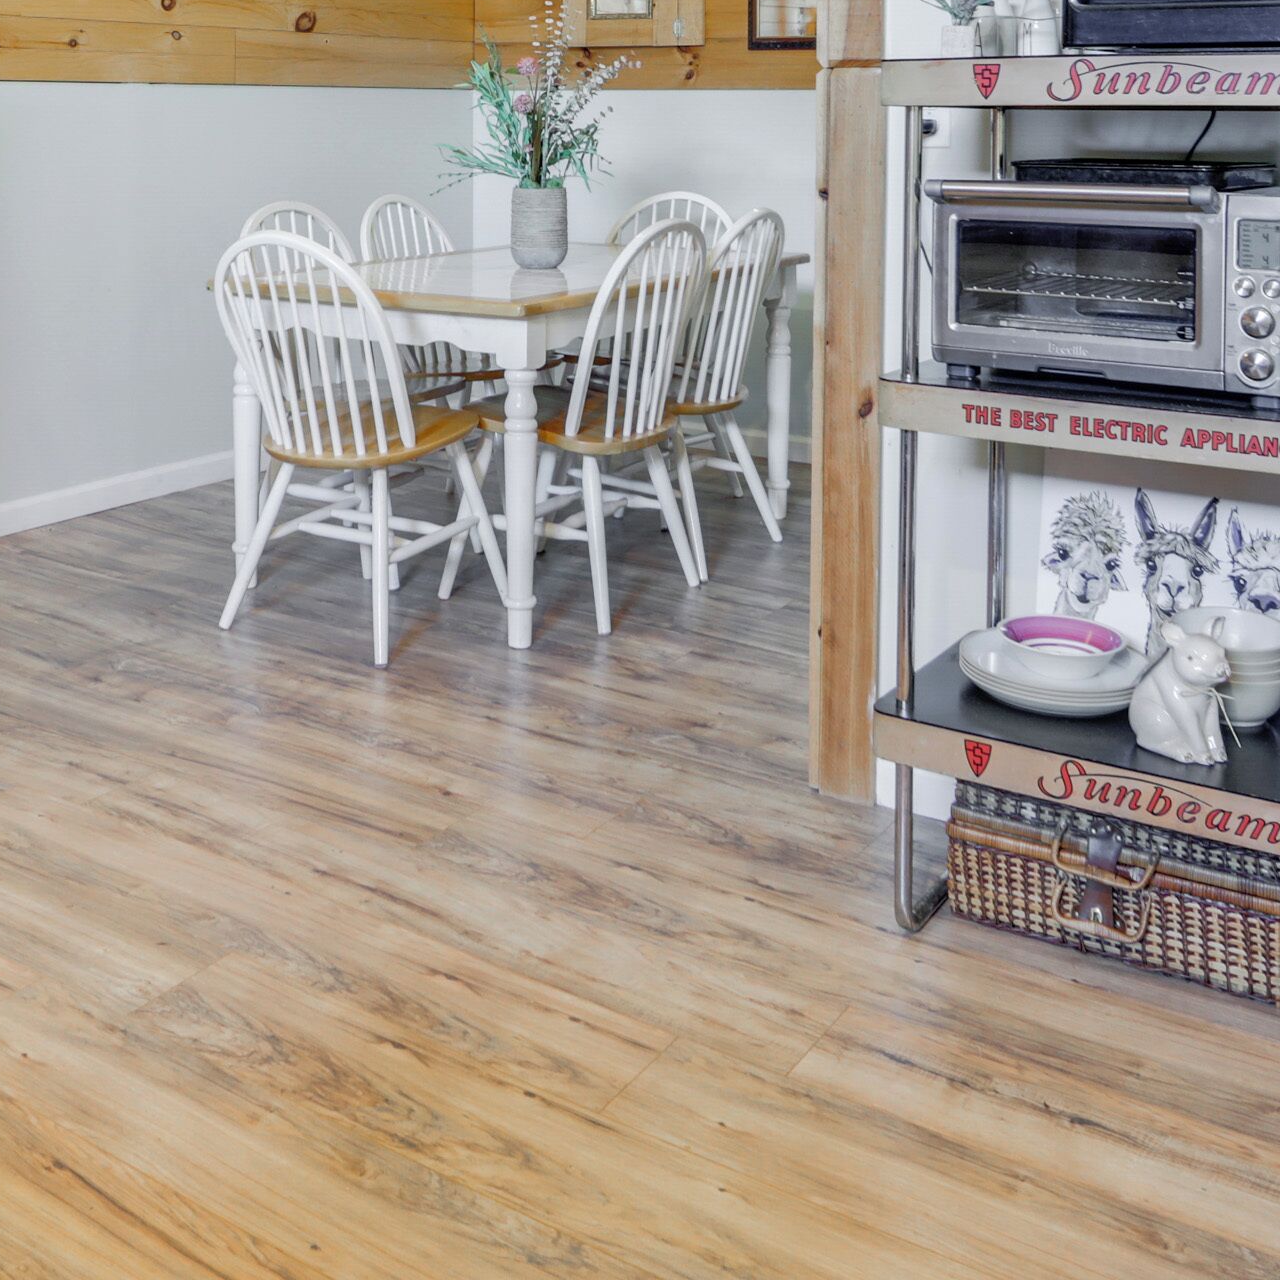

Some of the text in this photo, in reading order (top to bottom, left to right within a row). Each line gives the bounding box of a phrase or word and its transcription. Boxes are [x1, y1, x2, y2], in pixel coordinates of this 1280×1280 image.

[962, 404, 1001, 427] THE
[1010, 409, 1058, 432] BEST
[1070, 416, 1168, 446] ELECTRIC
